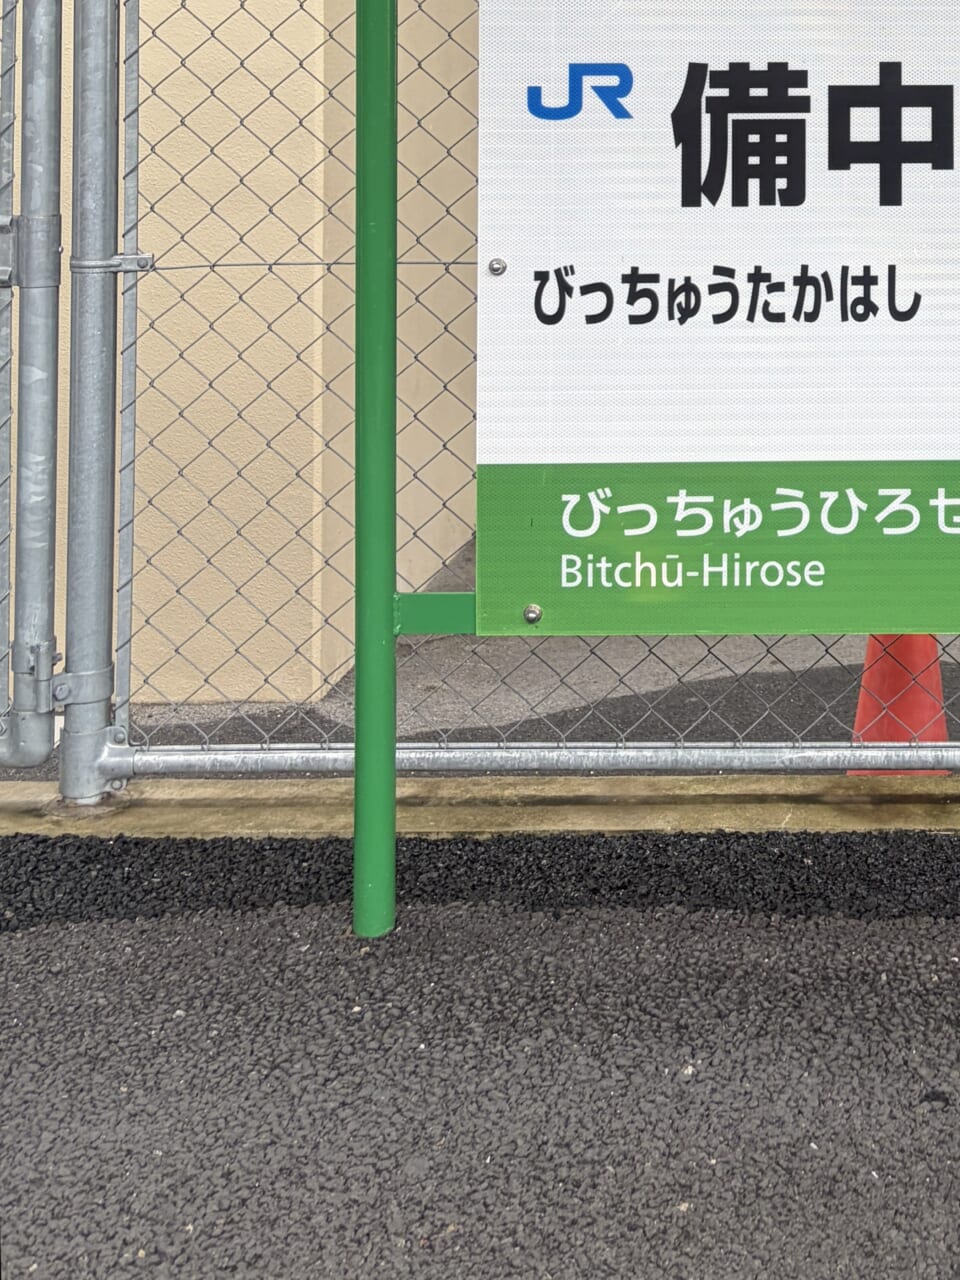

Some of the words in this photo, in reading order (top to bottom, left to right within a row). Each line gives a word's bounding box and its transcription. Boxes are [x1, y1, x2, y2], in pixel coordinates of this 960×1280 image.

[526, 62, 634, 122] JR
[533, 264, 922, 326] びっちゅうたかはし
[560, 551, 826, 589] Bitchū-Hirose
